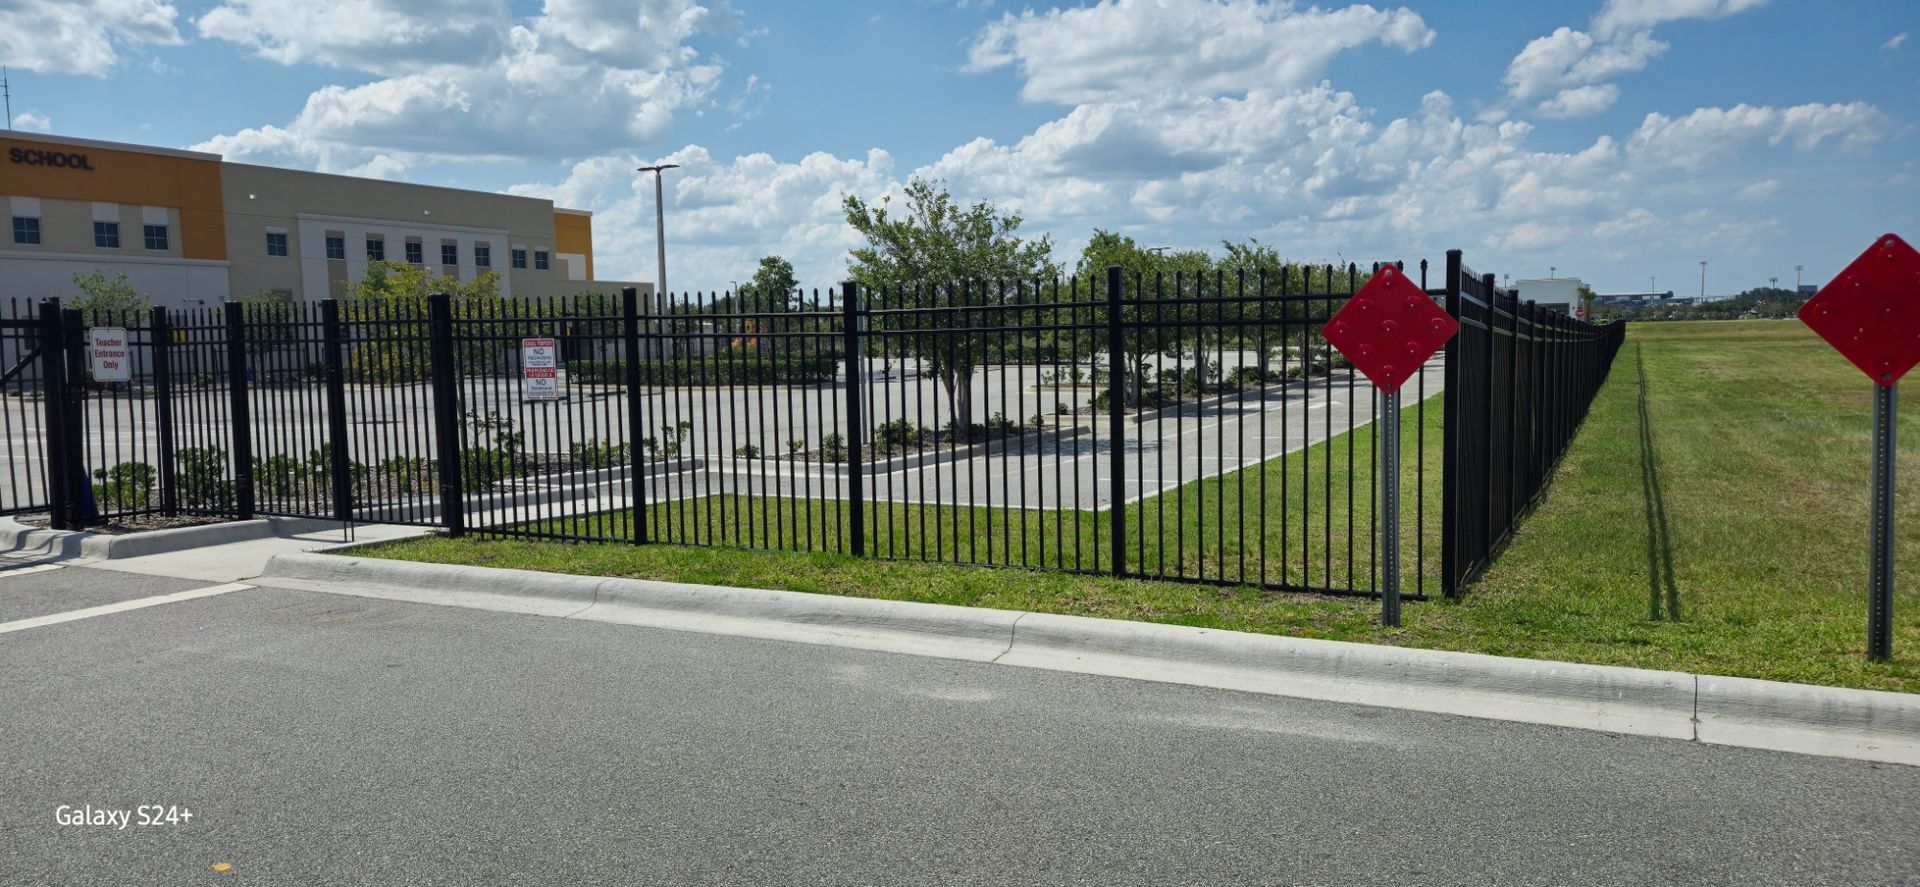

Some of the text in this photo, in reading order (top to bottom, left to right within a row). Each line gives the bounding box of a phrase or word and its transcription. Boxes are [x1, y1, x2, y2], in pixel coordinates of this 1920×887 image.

[9, 147, 95, 171] SCHOOL
[95, 338, 122, 347] Teacher
[95, 350, 125, 358] Entrance
[533, 347, 544, 355] NO
[103, 361, 119, 371] Only
